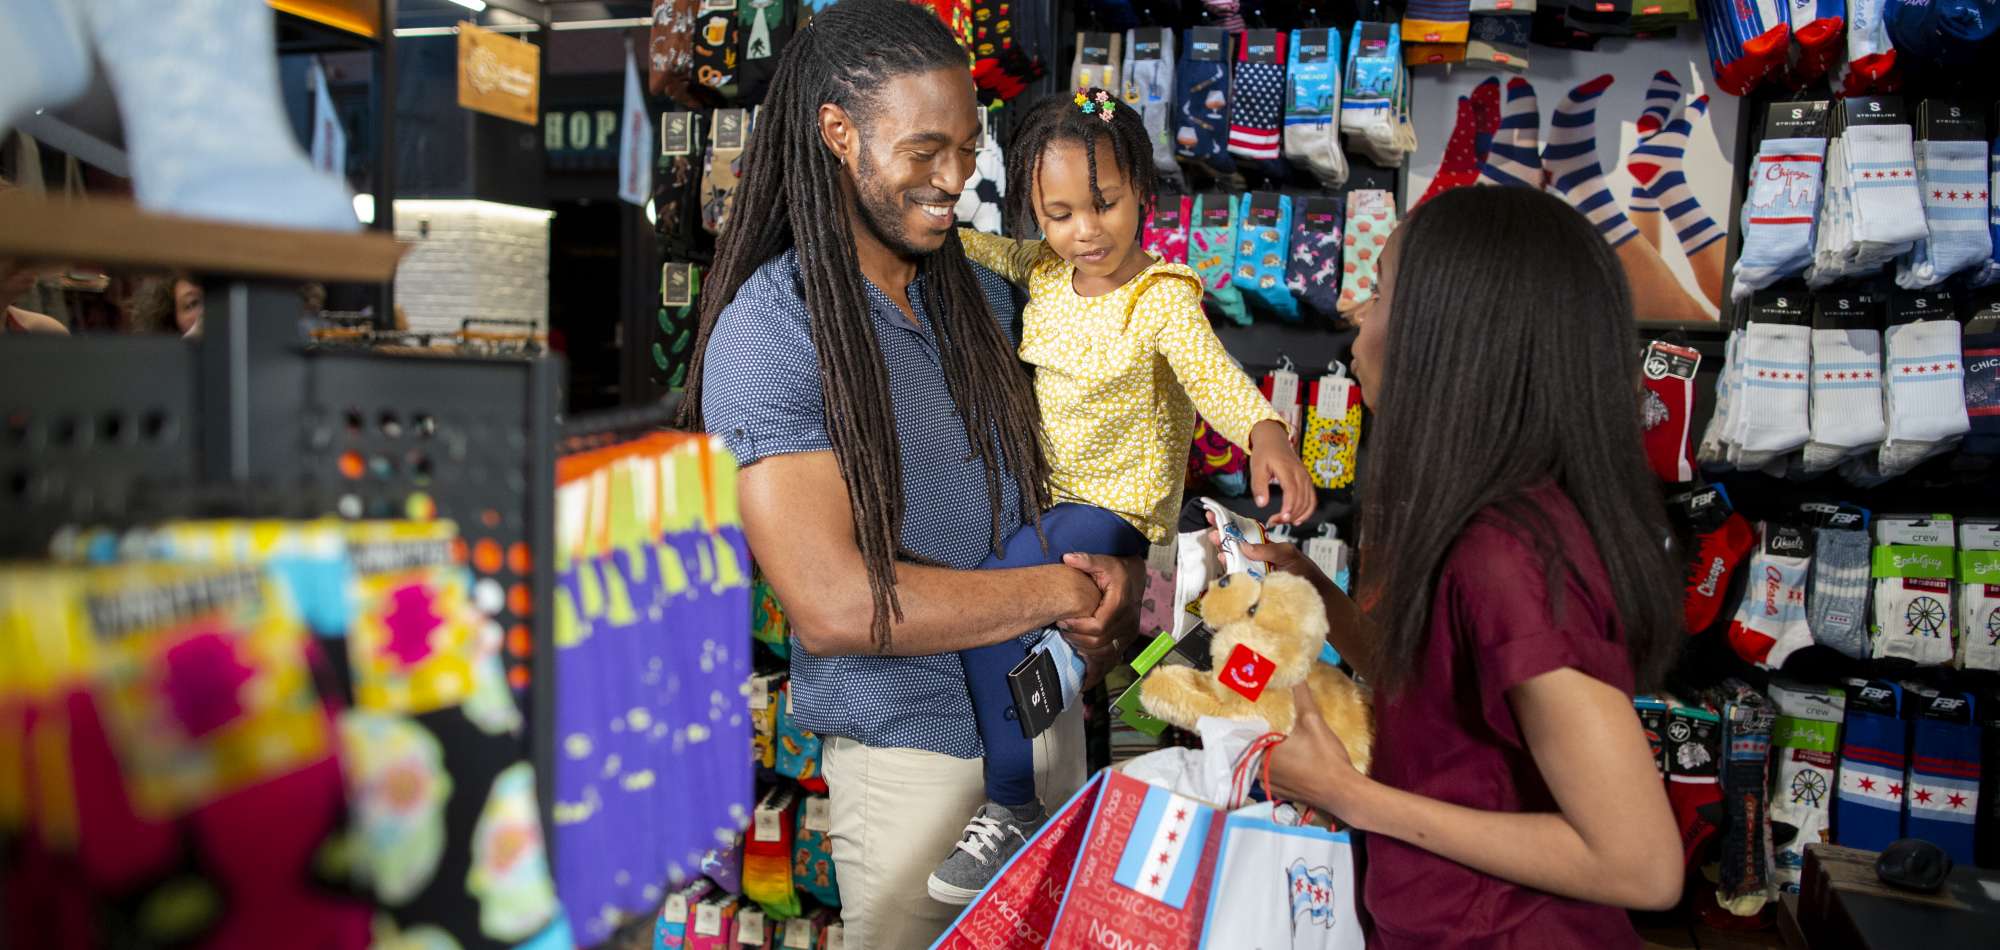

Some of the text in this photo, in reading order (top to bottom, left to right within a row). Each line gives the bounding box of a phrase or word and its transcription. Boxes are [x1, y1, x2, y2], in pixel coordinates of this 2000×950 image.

[1691, 491, 1717, 509] FBF
[1830, 512, 1861, 524] FBF
[1911, 534, 1939, 542] crew
[1697, 556, 1727, 597] Chicago
[1860, 686, 1893, 700] FBF
[1931, 697, 1966, 709] FBF
[1806, 707, 1829, 716] crew
[1077, 788, 1122, 888] Water Tower Place
[1106, 886, 1179, 928] CHICAGO
